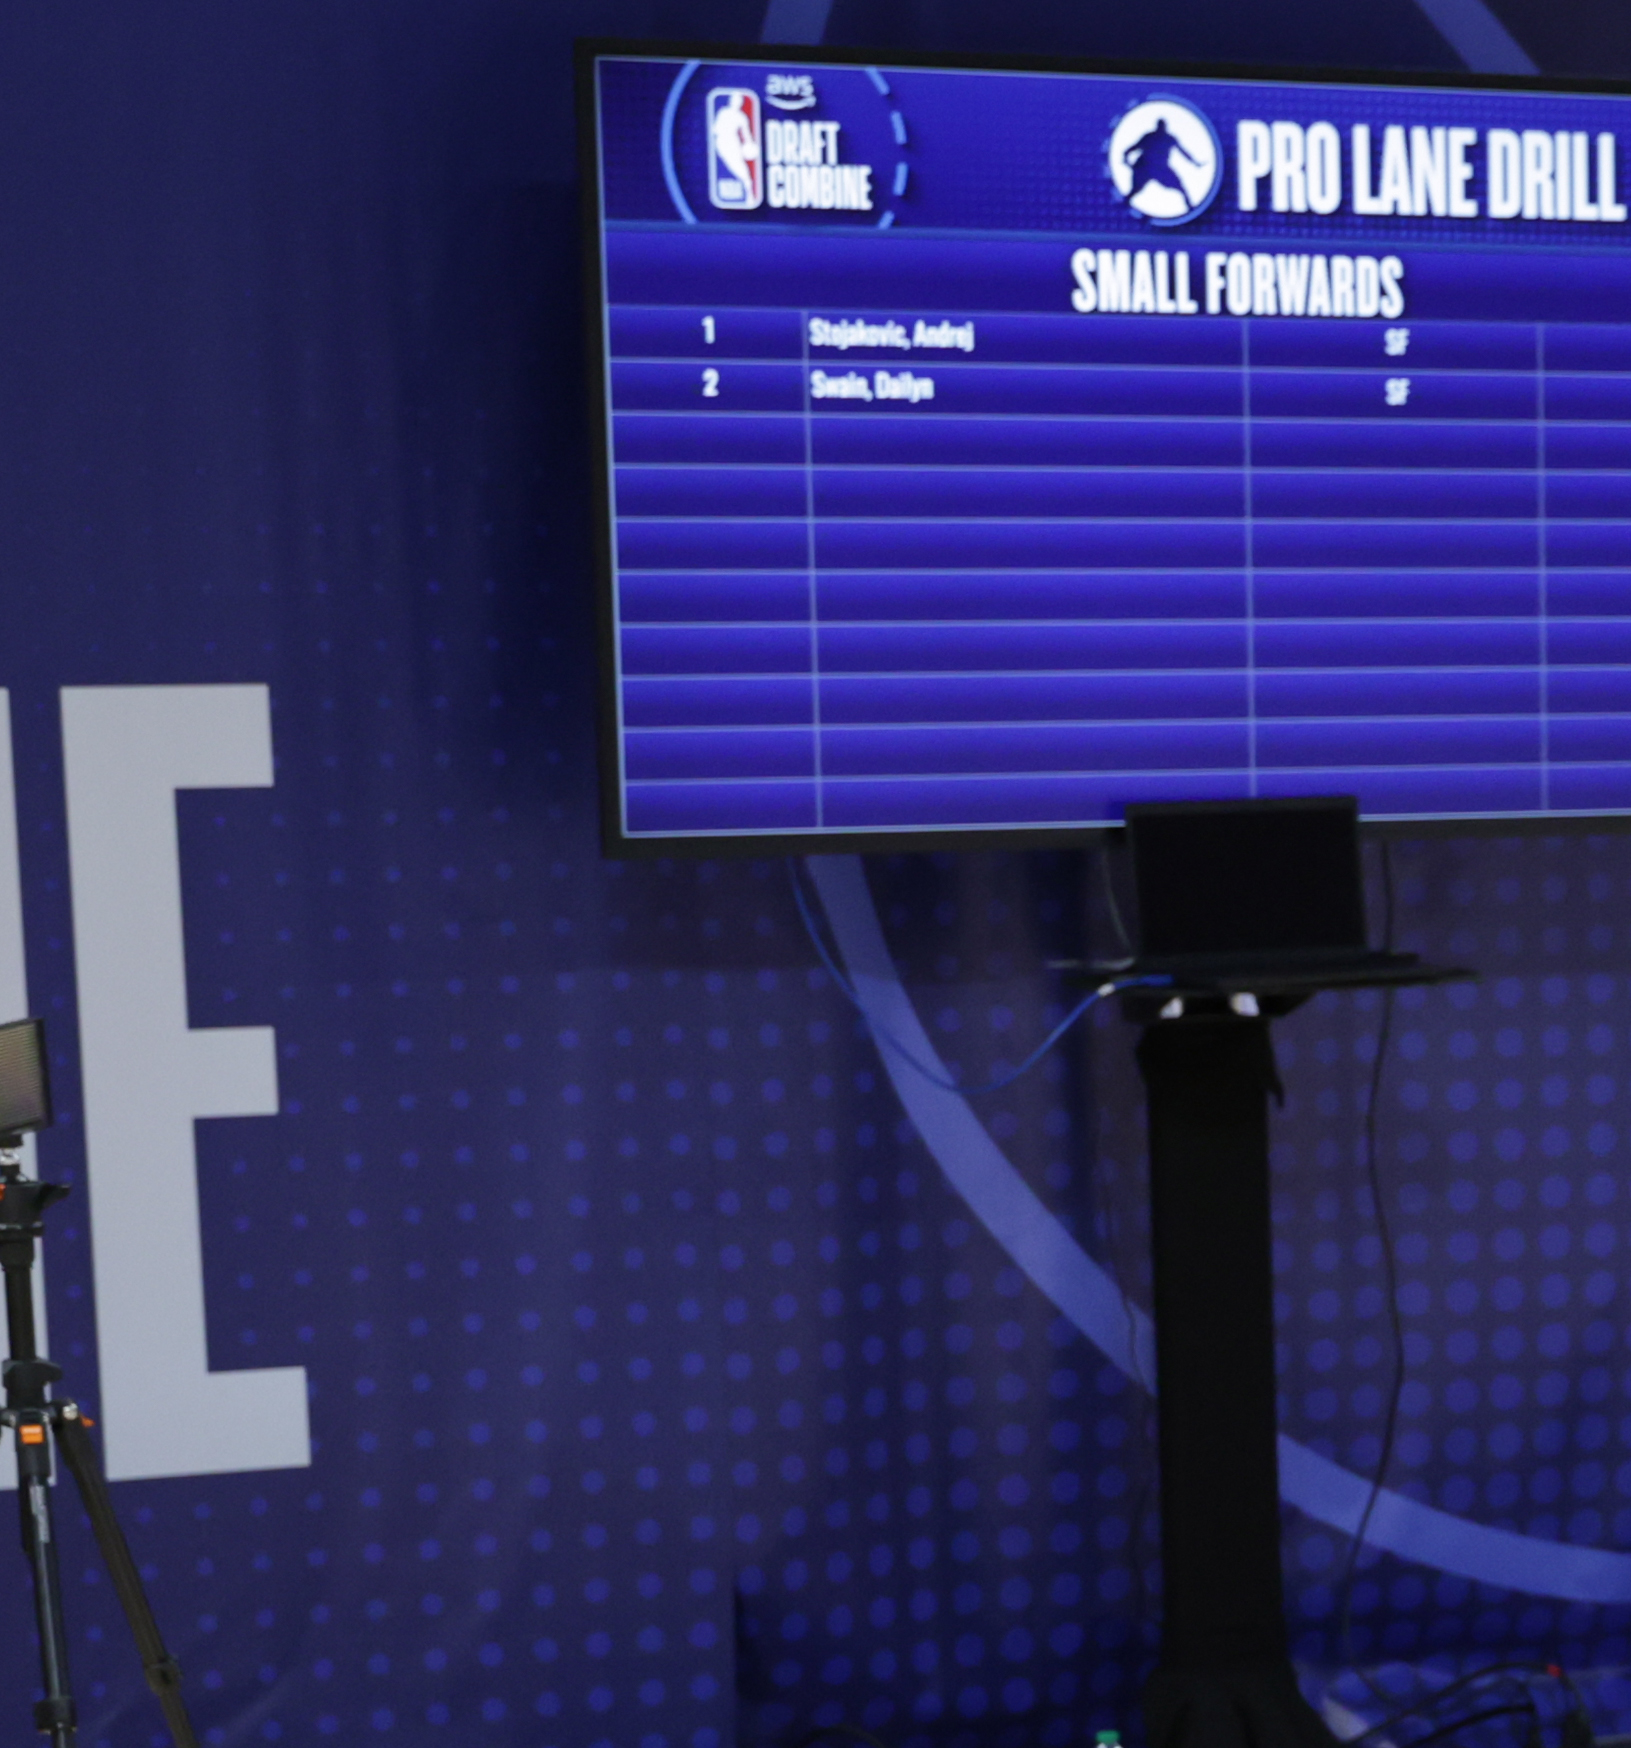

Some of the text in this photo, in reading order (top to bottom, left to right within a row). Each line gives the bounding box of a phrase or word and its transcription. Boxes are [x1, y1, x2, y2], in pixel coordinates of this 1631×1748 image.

[766, 74, 815, 96] aws
[765, 118, 841, 166] DRAFT
[766, 163, 874, 211] COMBINE
[1237, 119, 1627, 222] PRO LANE DRILL
[1071, 247, 1404, 319] SMALL FORWARDS
[701, 315, 715, 344] 1
[1384, 327, 1410, 356] SF
[702, 367, 720, 397] 2
[1385, 377, 1410, 406] SF
[0, 686, 310, 1488] E
